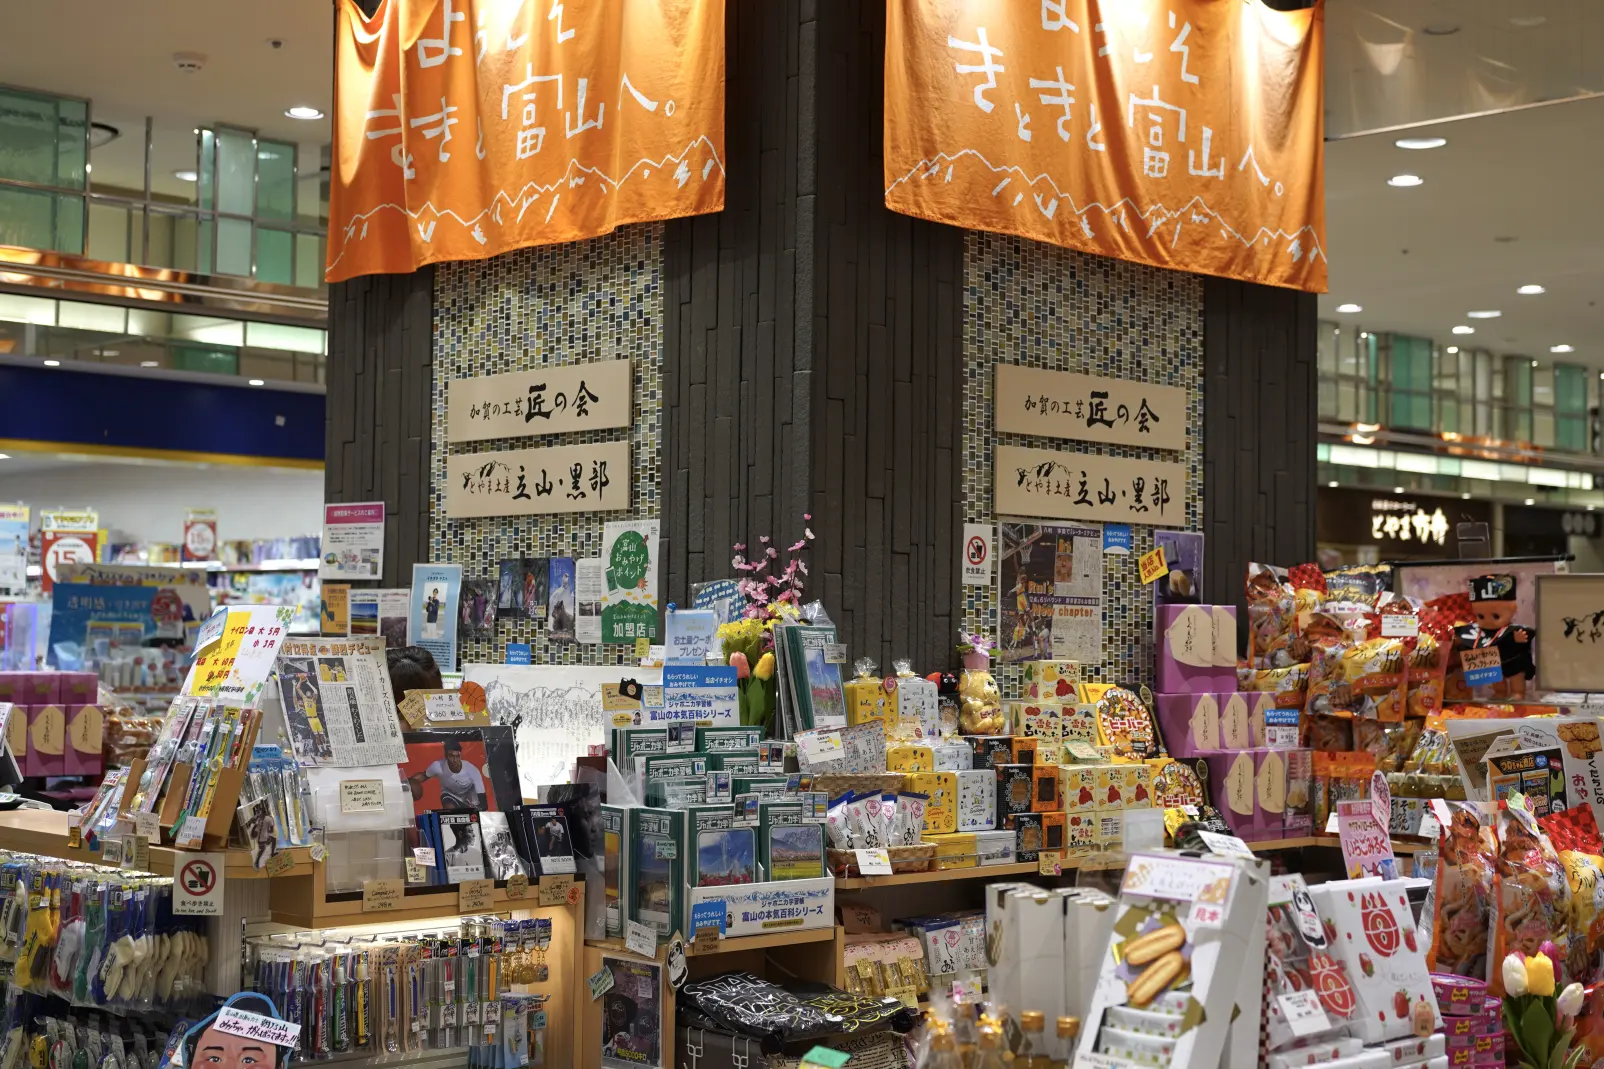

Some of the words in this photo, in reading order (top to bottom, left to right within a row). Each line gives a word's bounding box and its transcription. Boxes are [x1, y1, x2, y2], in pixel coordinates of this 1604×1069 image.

[615, 553, 644, 566] おみやげ
[616, 567, 642, 579] ポイント
[1058, 606, 1094, 618] chapter
[613, 622, 646, 638] 加盟店
[668, 700, 712, 708] ジャポニカ学習帳
[650, 708, 732, 721] 富山の本気百科シリーズ
[1109, 717, 1144, 730] ビーバー
[705, 739, 747, 749] ジャポニカ学習帳
[650, 767, 692, 777] ジャポニカ学習帳
[1163, 795, 1197, 807] ビーバー
[761, 899, 805, 908] ジャポニカ学習帳
[741, 905, 824, 923] 富山の本気百科シリーズ
[261, 1018, 288, 1032] 朝乃山
